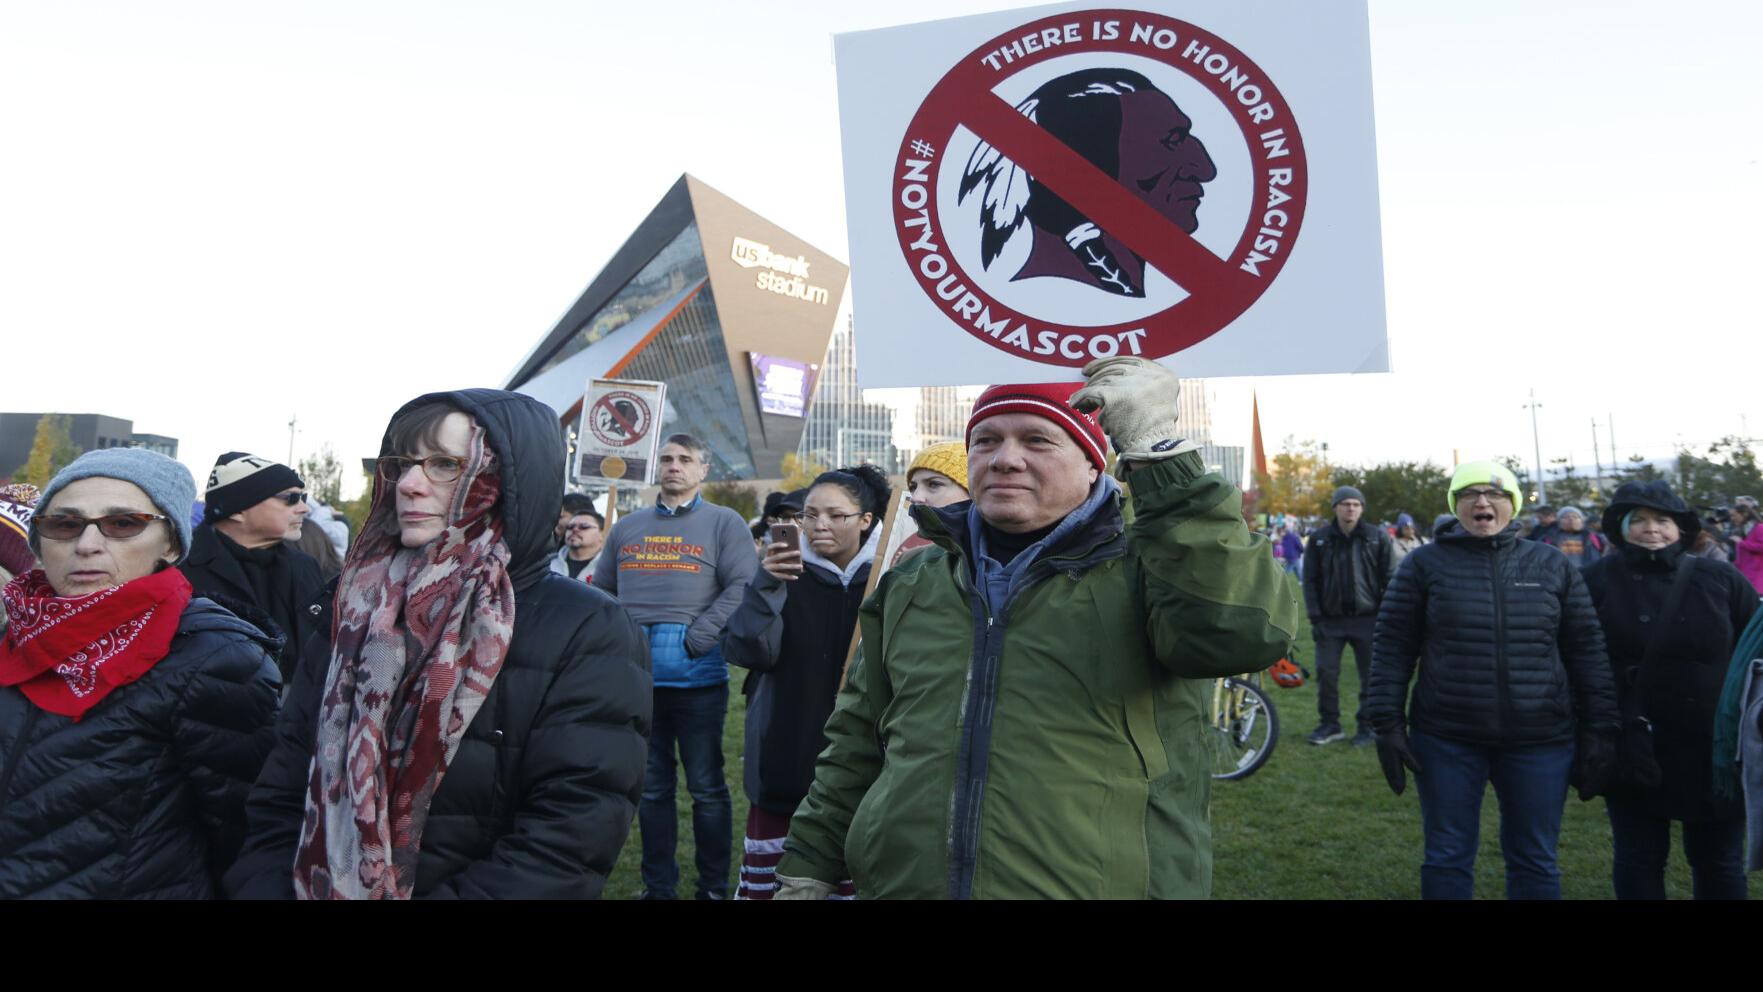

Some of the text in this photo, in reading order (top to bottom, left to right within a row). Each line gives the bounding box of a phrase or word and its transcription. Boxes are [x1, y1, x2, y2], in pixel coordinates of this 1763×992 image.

[981, 21, 1293, 278] THERE IS NO HONOR IN RACISM
[755, 270, 829, 305] stadium
[902, 139, 1147, 360] #NOTYOURMASCOT
[622, 543, 704, 557] NO HONOR
